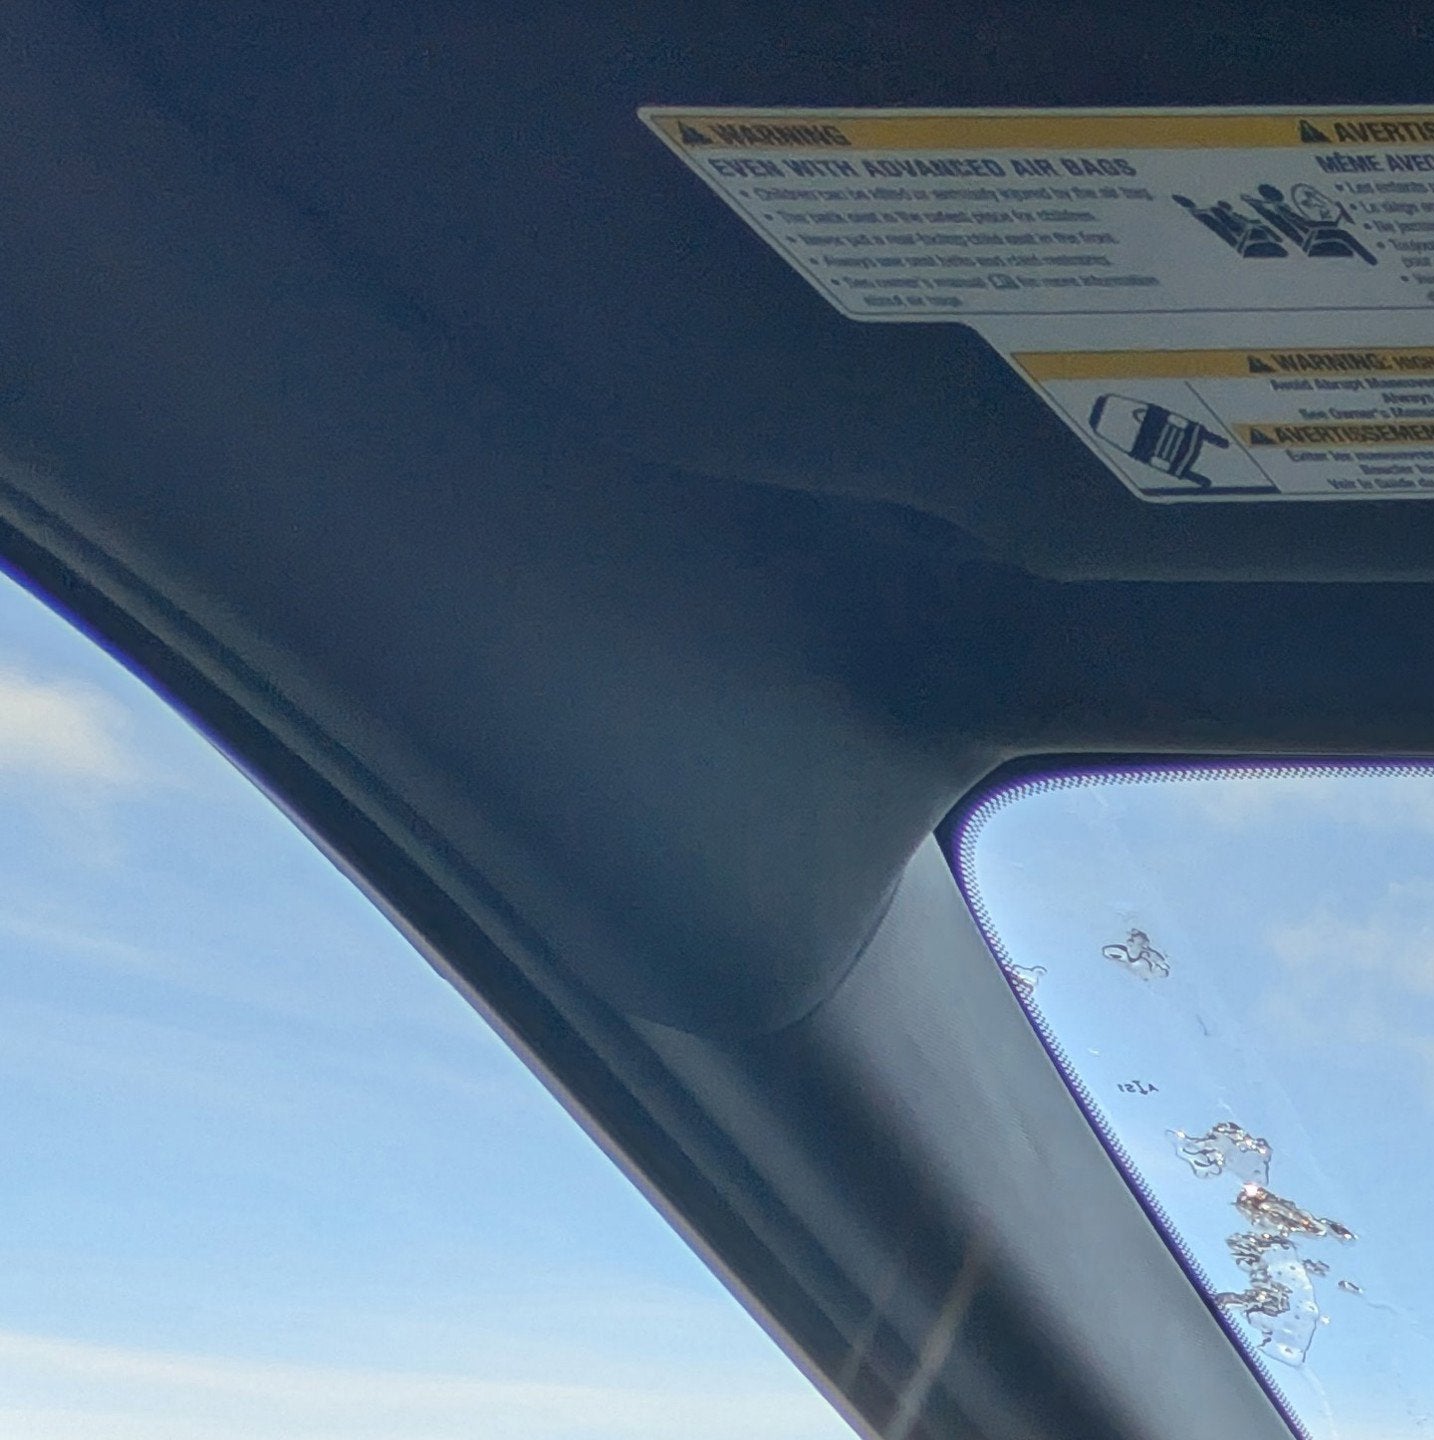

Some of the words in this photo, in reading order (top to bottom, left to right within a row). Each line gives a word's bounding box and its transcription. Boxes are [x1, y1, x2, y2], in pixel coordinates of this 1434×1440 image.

[709, 124, 851, 146] WARNING
[708, 159, 785, 177] EVEN
[782, 158, 860, 177] WITH
[861, 158, 1006, 177] ADVANCED
[1011, 158, 1060, 177] AIR
[1060, 158, 1137, 177] BAGS
[1315, 153, 1385, 173] MÊME
[1272, 353, 1392, 372] WARNING:
